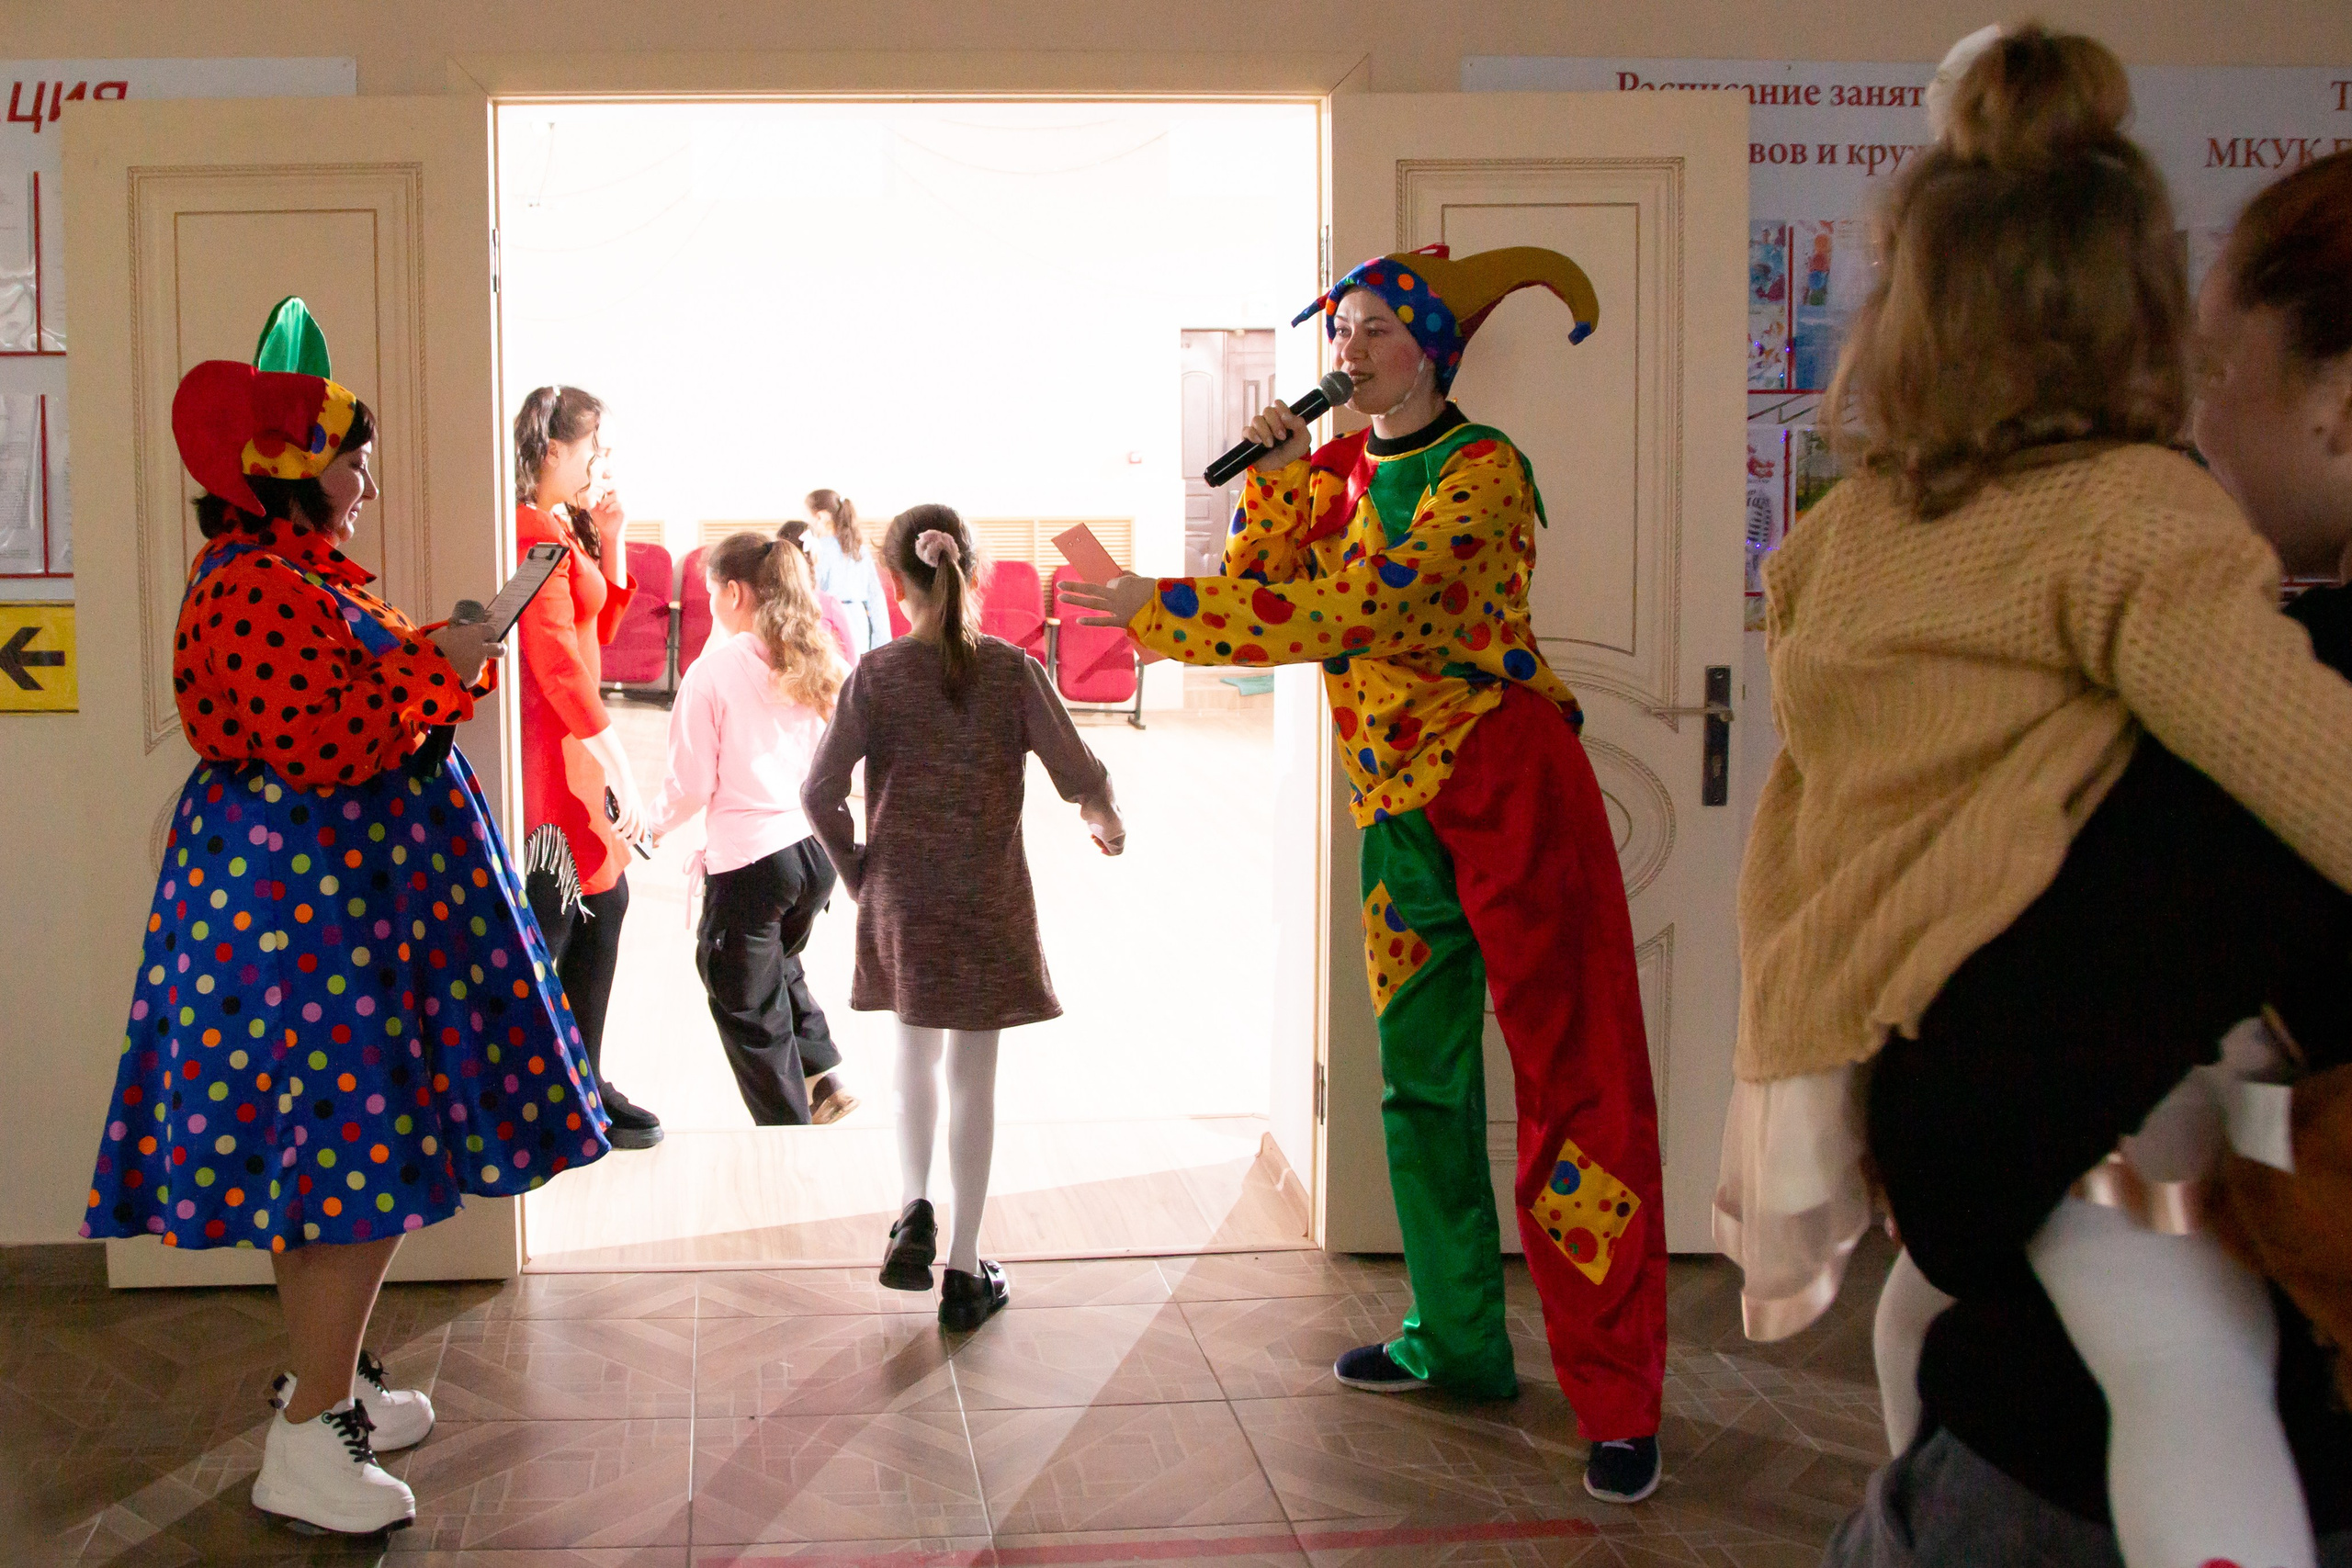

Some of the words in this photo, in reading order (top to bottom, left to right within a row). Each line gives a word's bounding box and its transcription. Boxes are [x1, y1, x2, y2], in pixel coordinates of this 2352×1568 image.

[1815, 143, 1838, 165] и
[1846, 142, 1929, 177] кру
[2205, 137, 2322, 169] МКУК
